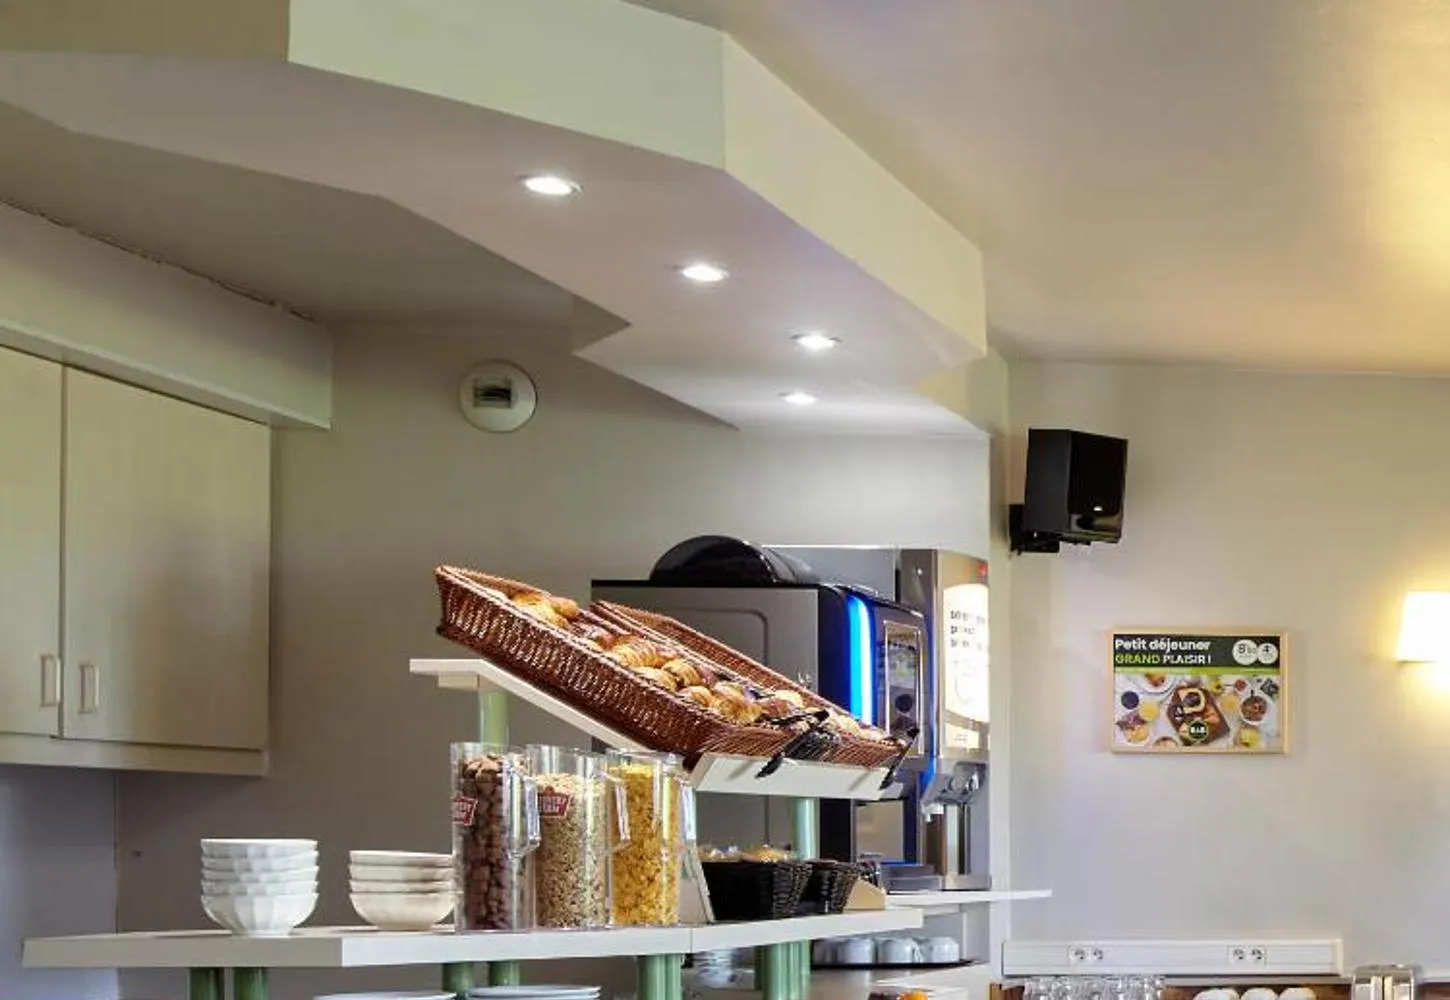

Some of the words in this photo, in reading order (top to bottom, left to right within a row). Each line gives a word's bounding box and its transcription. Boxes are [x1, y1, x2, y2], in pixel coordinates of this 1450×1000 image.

[1115, 638, 1147, 650] Petit
[1149, 638, 1211, 653] déjeuner
[1115, 653, 1161, 664] GRAND
[1162, 654, 1206, 664] PLAISIR
